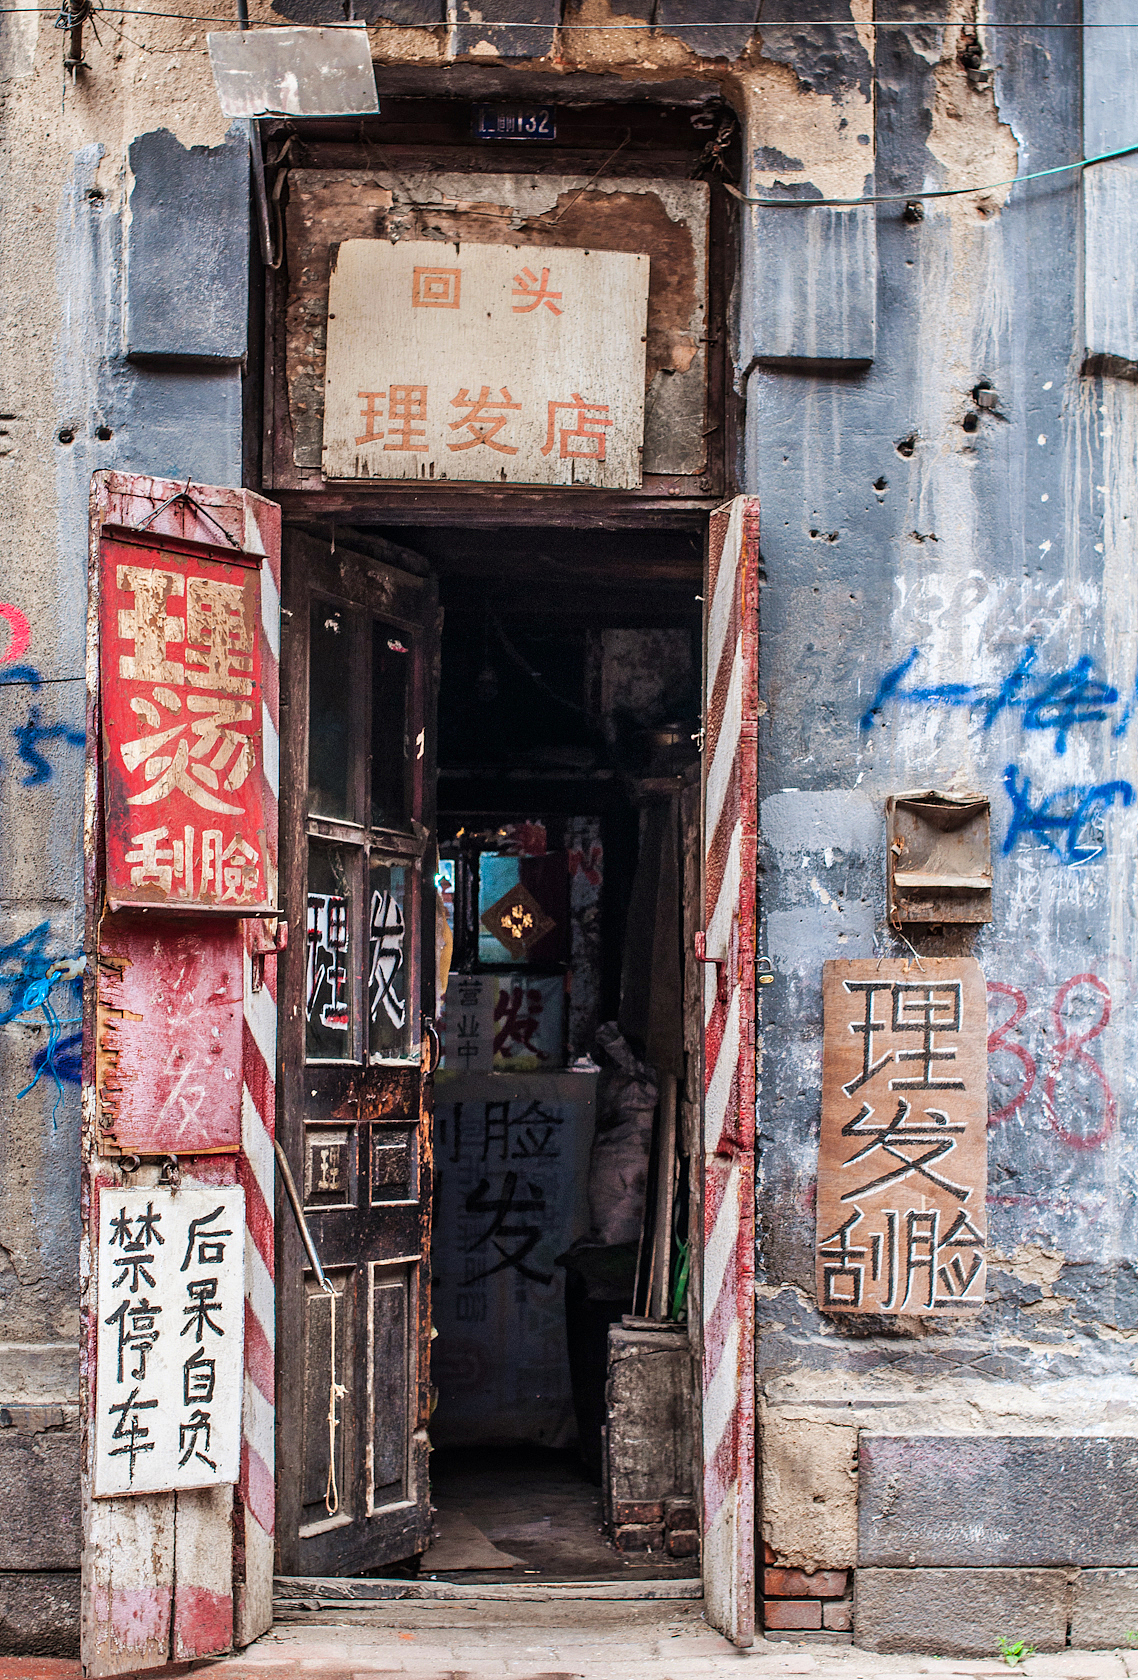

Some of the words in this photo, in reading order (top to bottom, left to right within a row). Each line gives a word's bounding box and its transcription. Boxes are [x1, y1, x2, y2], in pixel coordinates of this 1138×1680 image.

[517, 110, 550, 133] 132
[411, 266, 563, 316] 回头
[354, 384, 614, 462] 理发店
[457, 980, 486, 1068] 营业中
[841, 980, 973, 1202] 理发
[817, 1206, 988, 1310] 刮脸
[105, 1201, 166, 1489] 禁停车
[177, 1205, 234, 1473] 后果自负
